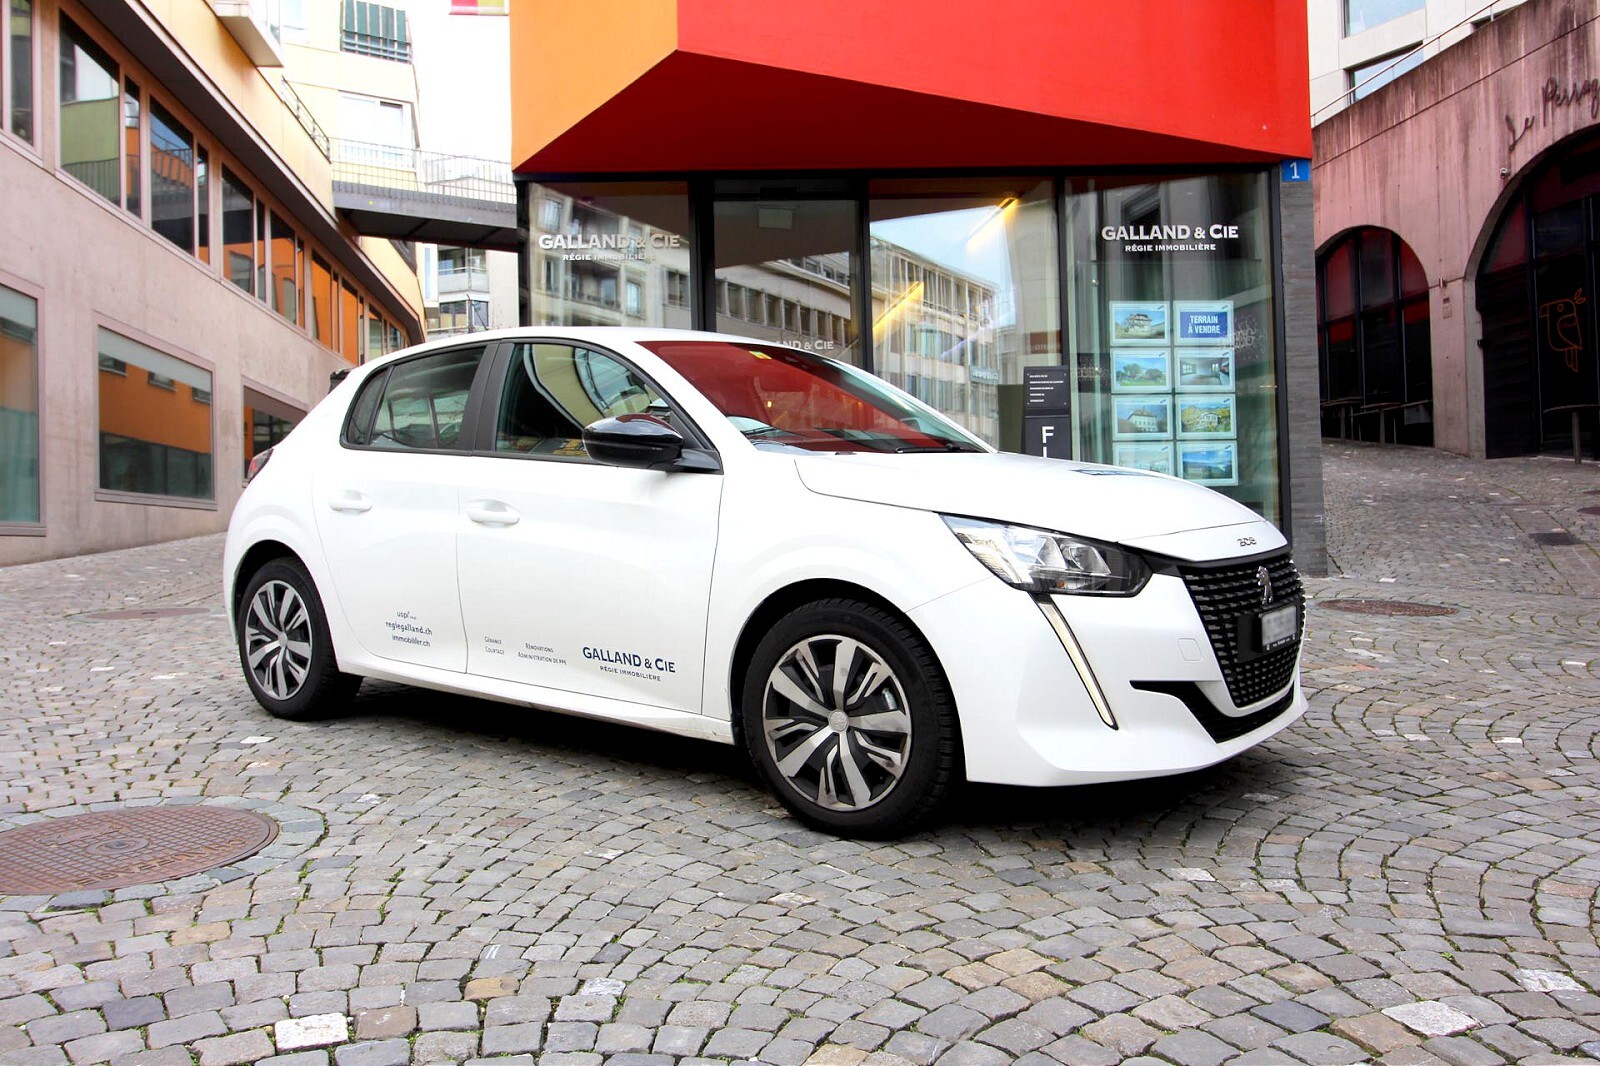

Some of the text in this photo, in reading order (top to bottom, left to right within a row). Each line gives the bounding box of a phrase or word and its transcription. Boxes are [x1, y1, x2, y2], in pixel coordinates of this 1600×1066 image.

[1289, 161, 1300, 179] 1
[1101, 224, 1239, 241] GALLAND & CIE
[538, 233, 681, 249] GALLAND & CIE
[1125, 243, 1216, 252] RÉGIE IMMOBILIÈRE
[562, 252, 592, 261] RÉGIE
[1189, 315, 1218, 324] TERRAIN
[1188, 323, 1221, 334] À VENDRE
[804, 342, 813, 350] &
[814, 340, 835, 350] CIE
[582, 646, 676, 673] GALLAND & CIE
